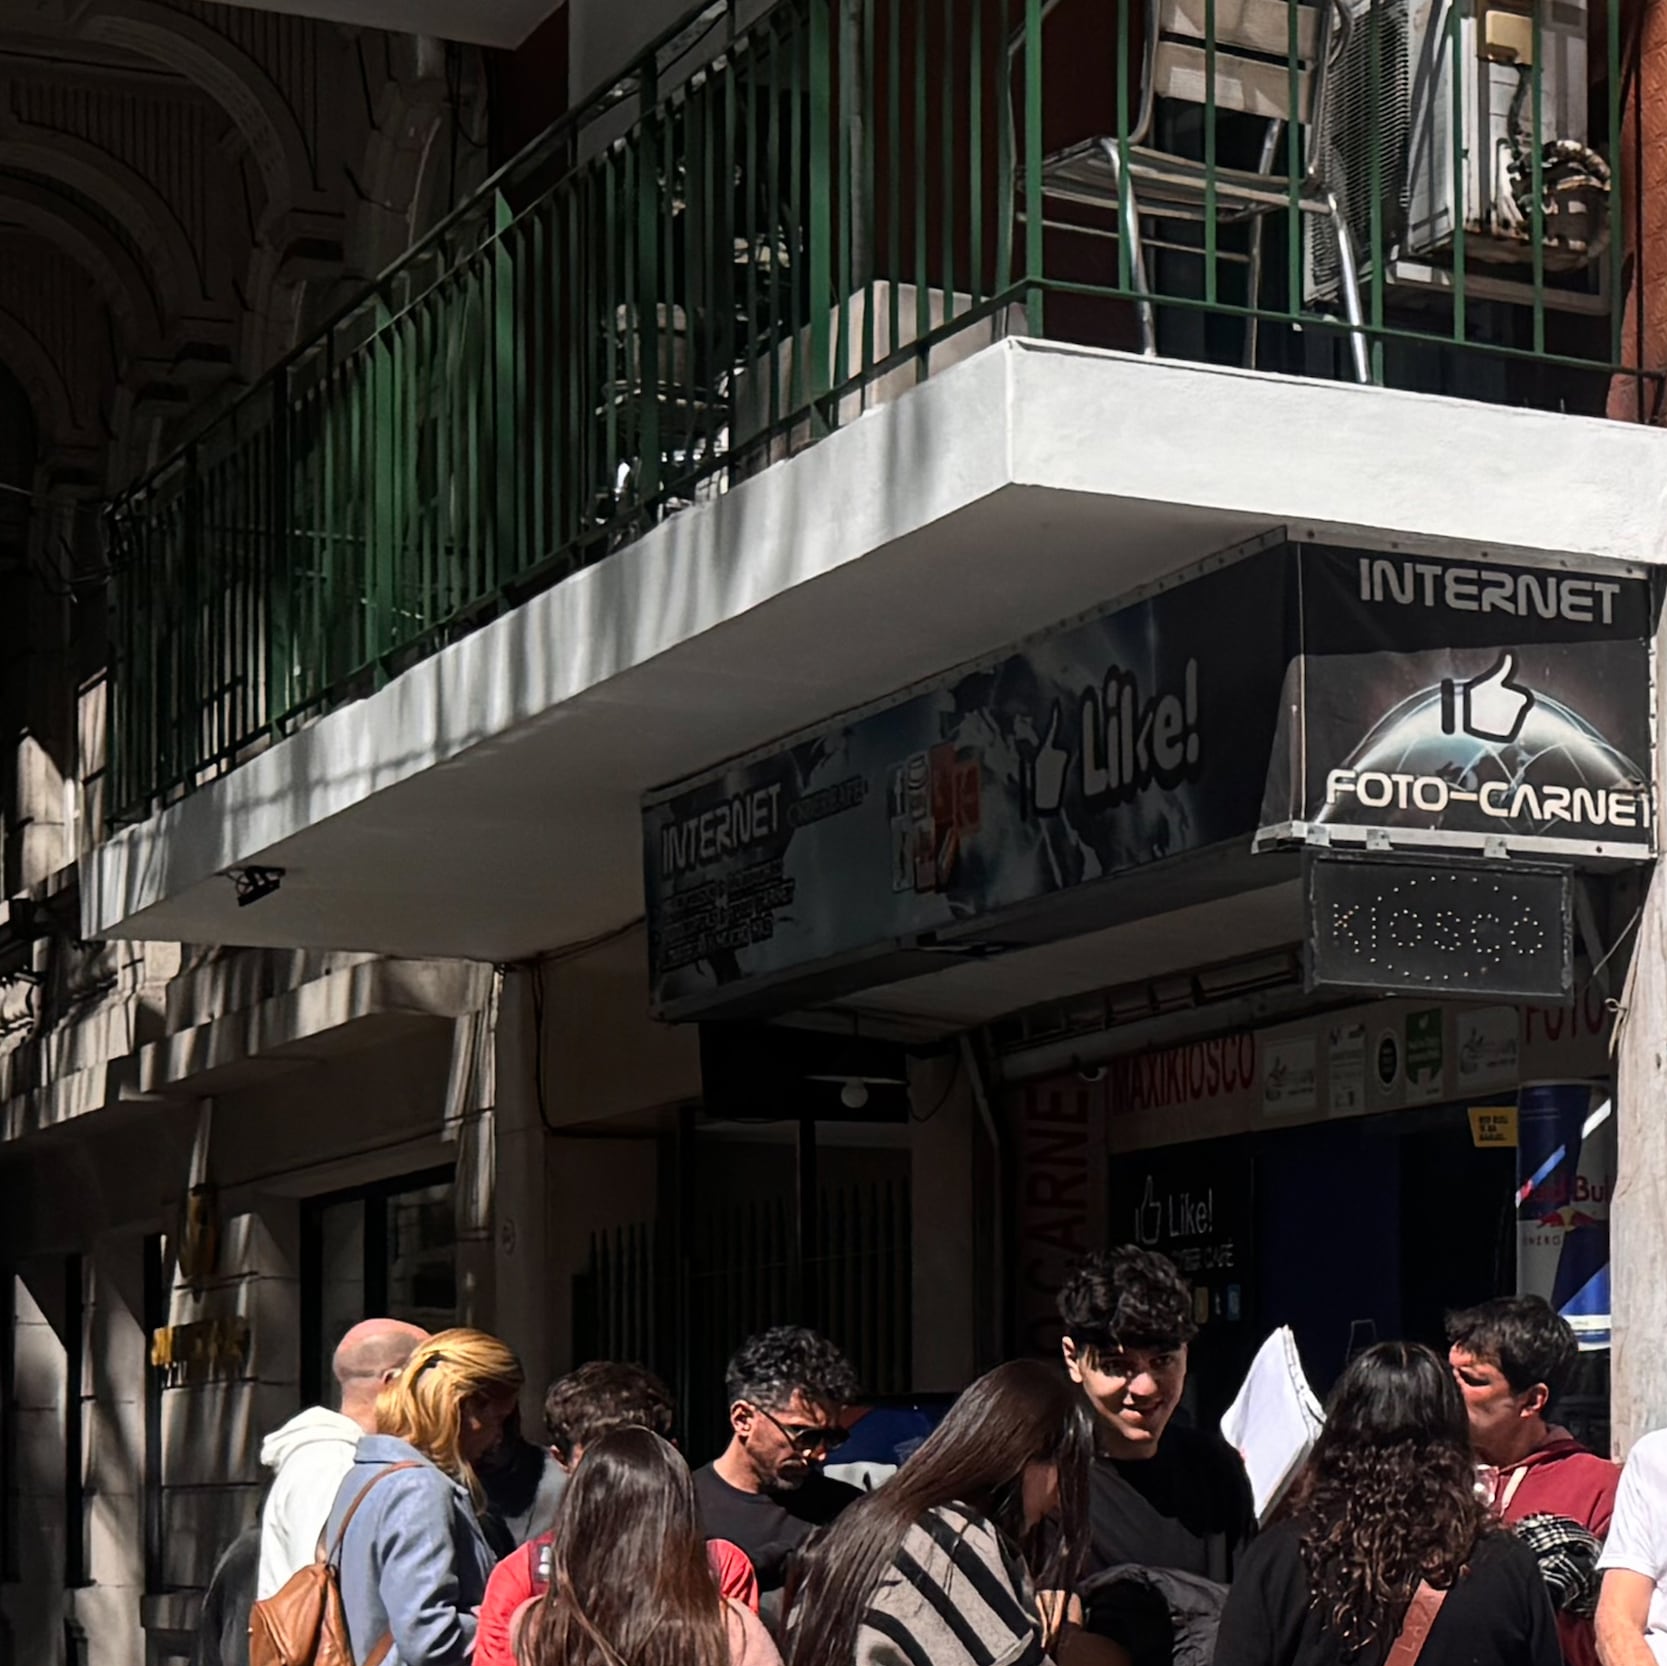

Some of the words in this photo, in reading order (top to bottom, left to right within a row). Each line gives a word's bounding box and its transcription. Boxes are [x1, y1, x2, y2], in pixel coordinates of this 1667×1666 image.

[1358, 558, 1621, 625] INTERNET
[1082, 657, 1199, 798] Like!
[661, 782, 782, 879] INTERNET
[1105, 1033, 1254, 1116] MAXIKIOSCO
[1168, 1186, 1213, 1238] Like!
